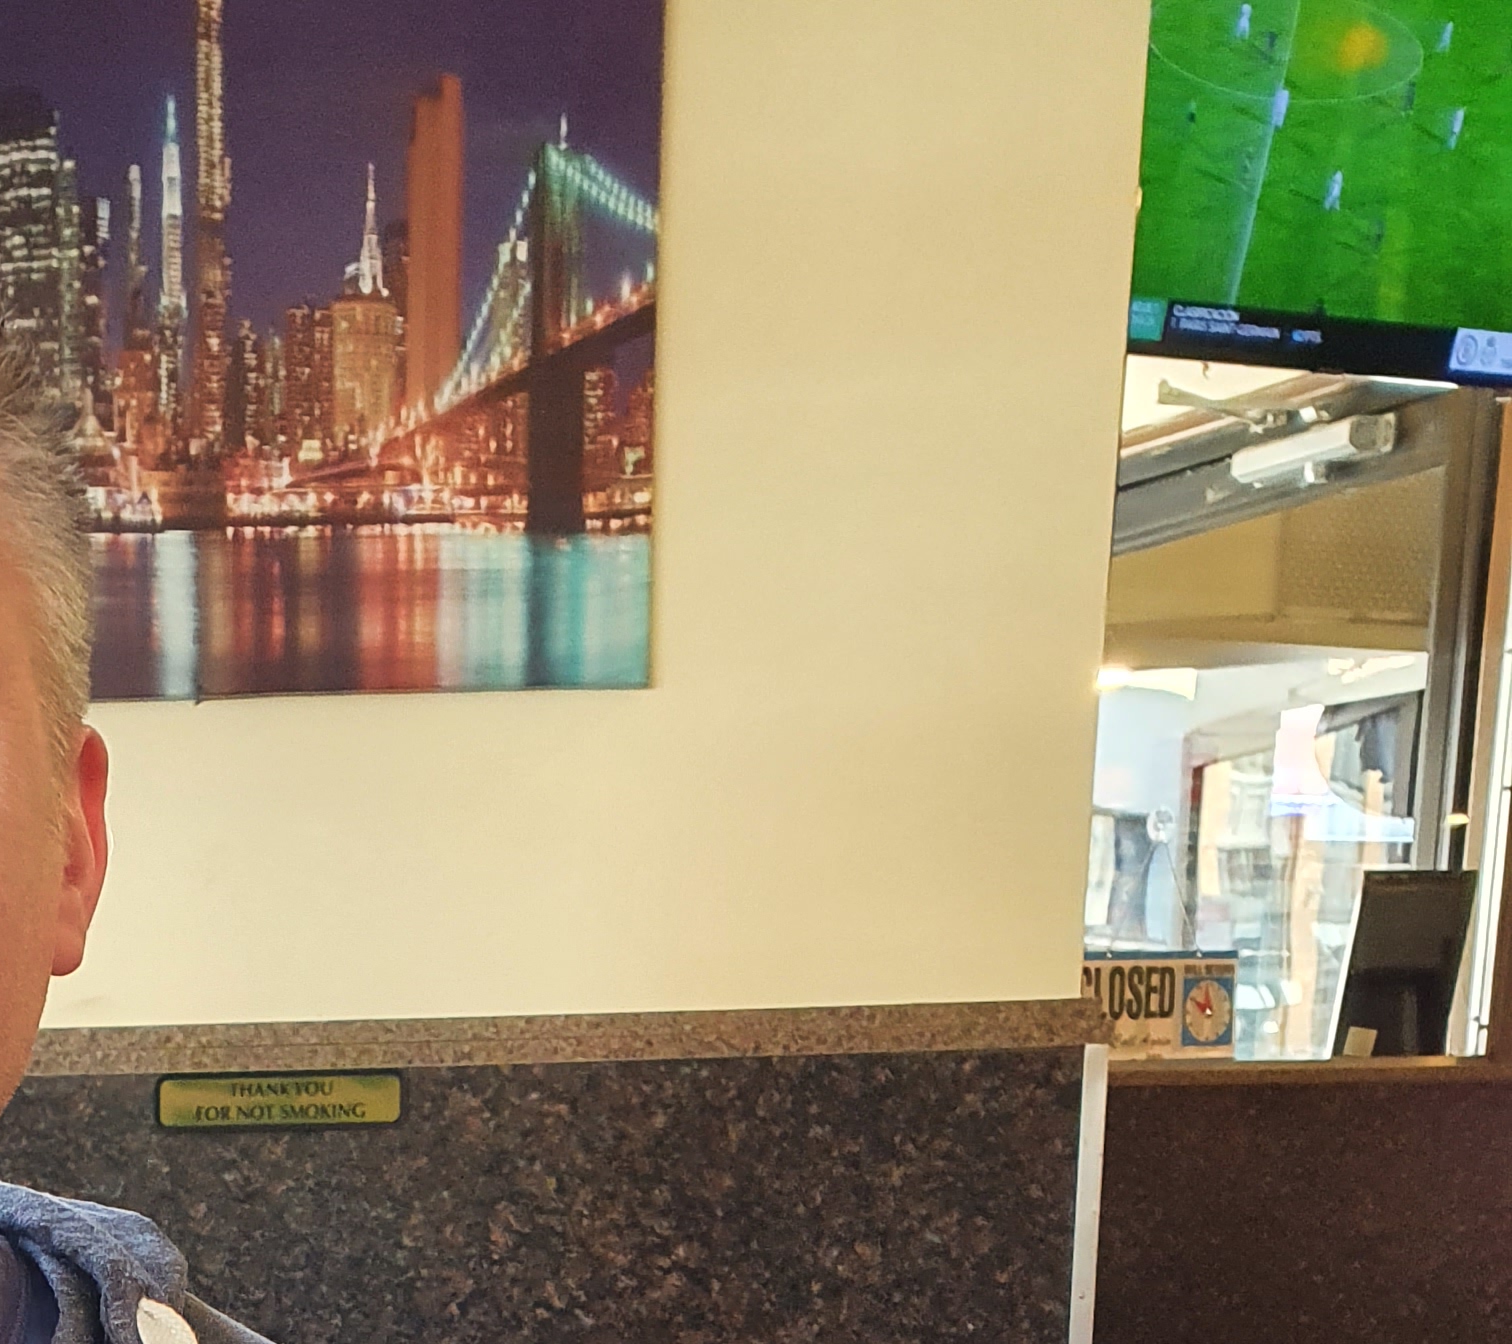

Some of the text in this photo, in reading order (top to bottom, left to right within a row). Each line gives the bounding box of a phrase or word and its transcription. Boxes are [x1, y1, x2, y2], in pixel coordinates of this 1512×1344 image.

[231, 1080, 335, 1098] THANK YOU
[194, 1101, 367, 1122] FOR NOT SMOKING
